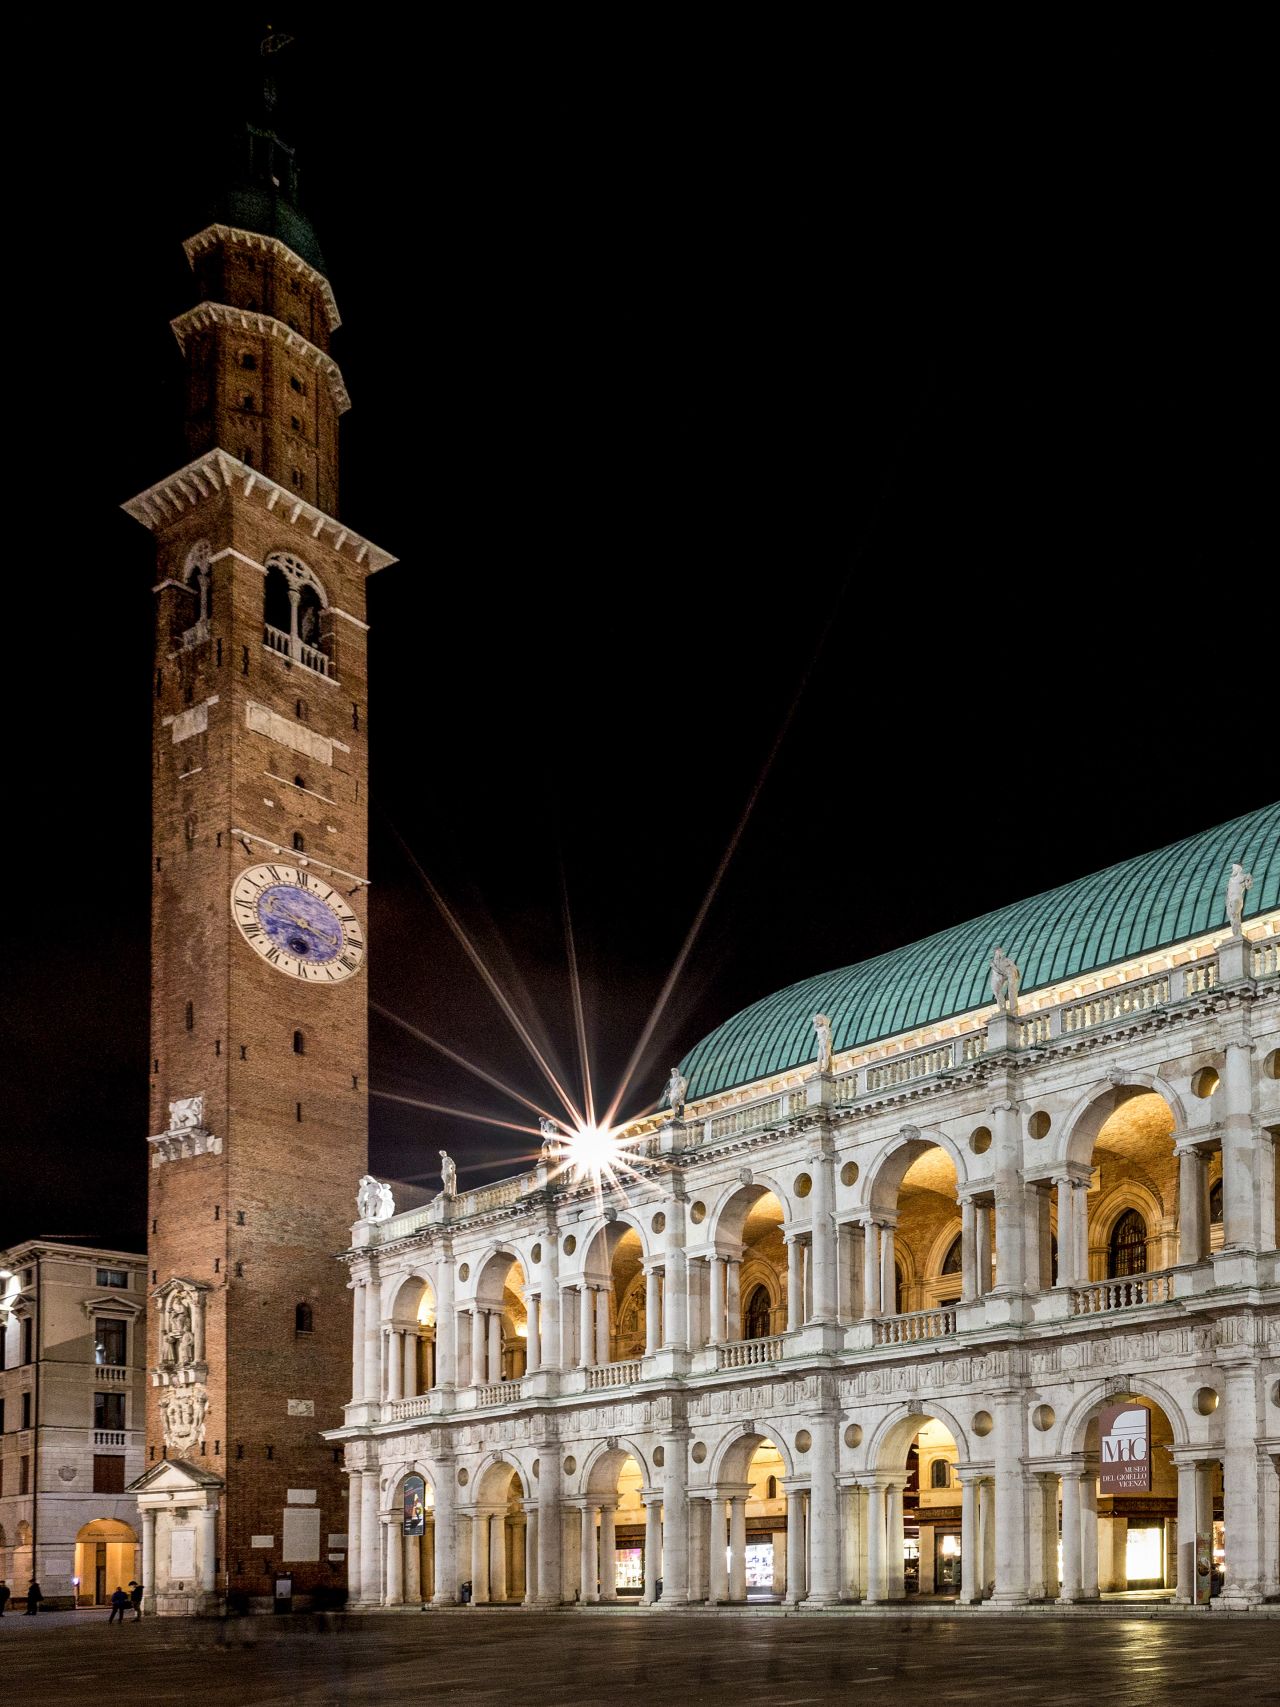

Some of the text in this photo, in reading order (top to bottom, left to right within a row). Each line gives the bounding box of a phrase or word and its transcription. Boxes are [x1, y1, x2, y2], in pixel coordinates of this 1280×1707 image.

[296, 869, 309, 887] XII
[323, 890, 334, 901] I
[347, 937, 362, 949] III
[1102, 1437, 1147, 1461] MdG
[1102, 1472, 1147, 1482] DEL GIOIELLO
[1118, 1480, 1147, 1488] VICENZA
